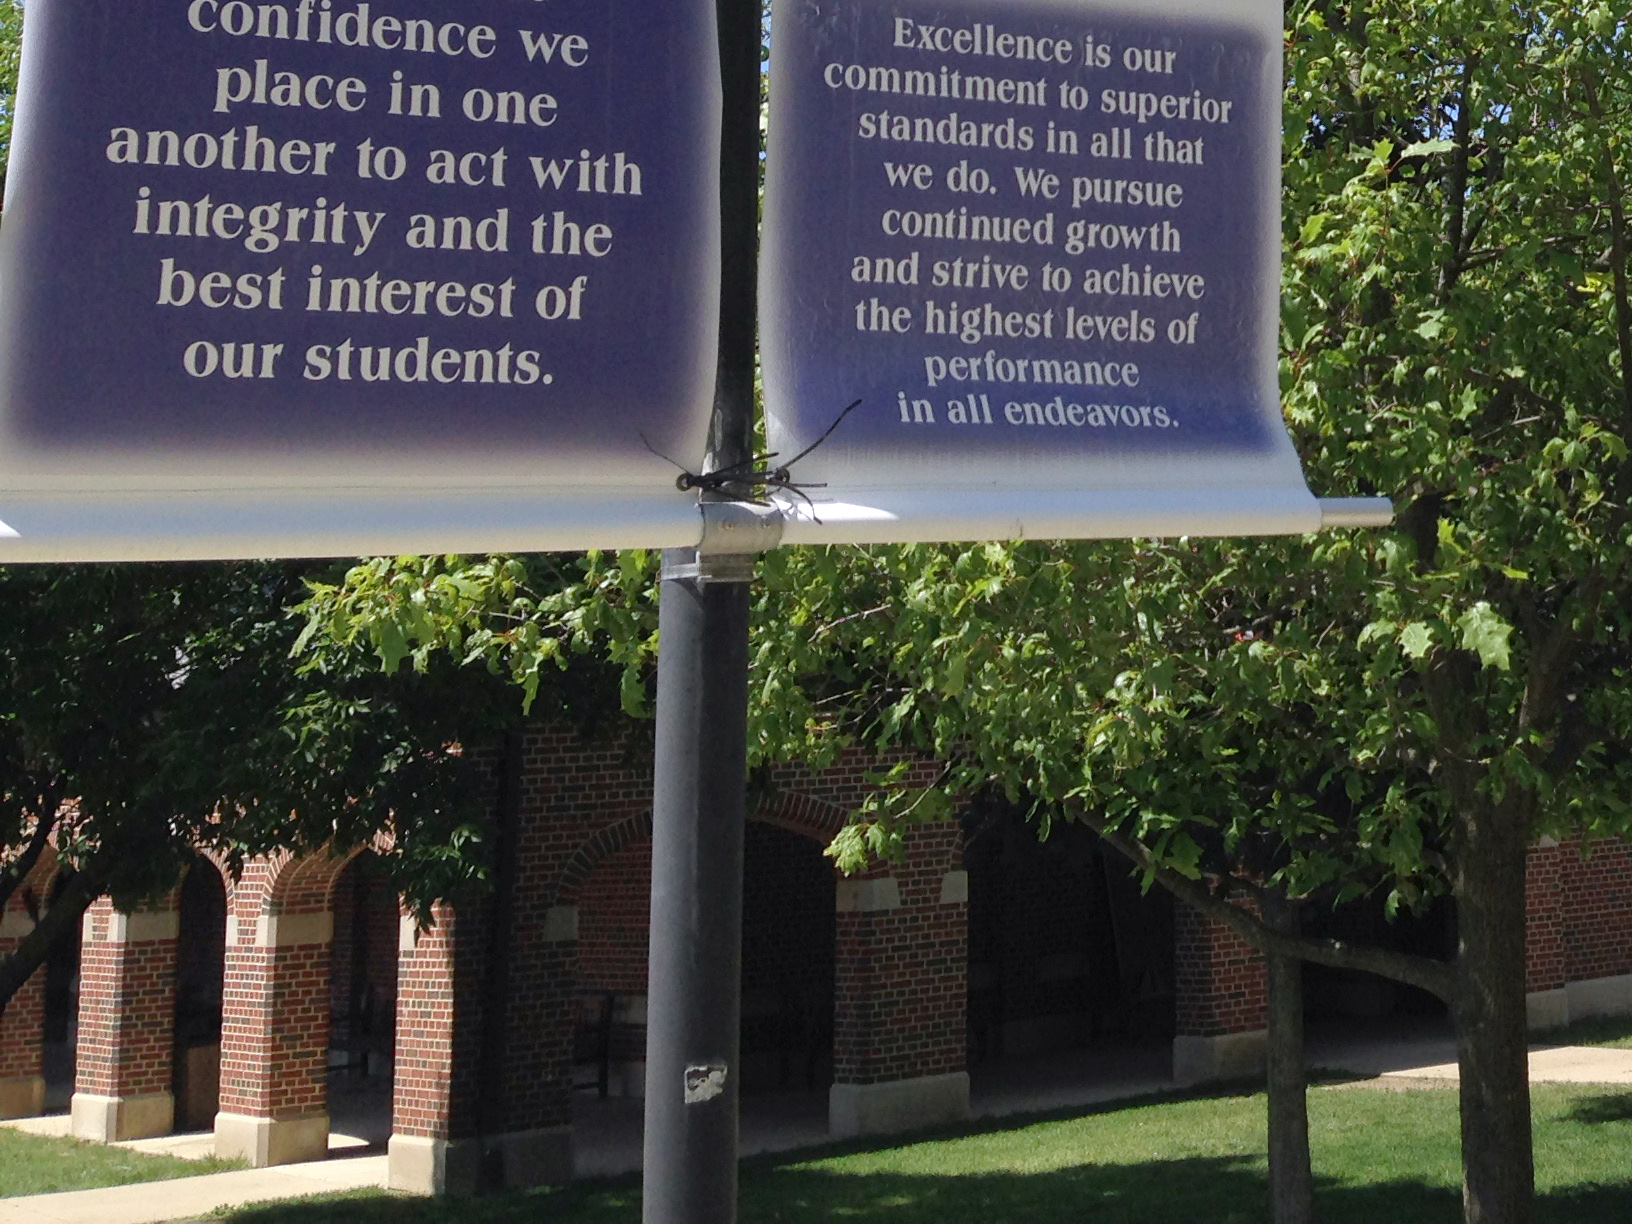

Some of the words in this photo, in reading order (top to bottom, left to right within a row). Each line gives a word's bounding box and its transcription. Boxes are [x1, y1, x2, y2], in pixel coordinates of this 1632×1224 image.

[518, 27, 589, 67] we
[893, 17, 1072, 64] Excellence
[1085, 35, 1110, 68] is
[1123, 46, 1176, 74] our
[212, 58, 366, 112] place
[387, 70, 441, 117] in
[462, 88, 558, 126] one
[824, 62, 1047, 106] commitment
[1059, 81, 1089, 111] to
[1100, 87, 1232, 124] superior
[106, 124, 336, 175] another
[357, 137, 406, 181] to
[426, 146, 507, 187] act
[529, 149, 643, 196] with
[859, 110, 1034, 151] standards
[1046, 121, 1078, 155] in
[1090, 126, 1131, 160] all
[1144, 132, 1203, 165] that
[884, 161, 932, 189] we
[947, 160, 996, 195] do.
[1014, 166, 1060, 199] We
[1072, 176, 1182, 208] pursue
[133, 186, 386, 256] integrity
[406, 208, 509, 252] and
[531, 211, 613, 257] the
[882, 207, 1053, 246] continued
[1065, 219, 1181, 255] growth
[156, 258, 287, 310] best
[305, 264, 516, 318] interest
[535, 276, 588, 320] of
[851, 251, 919, 285] and
[932, 255, 1028, 291] strive
[1042, 261, 1071, 293] to
[1083, 264, 1204, 299] achieve
[855, 298, 912, 333] the
[925, 300, 1053, 344] highest
[1066, 306, 1156, 343] levels
[1168, 311, 1200, 345] of
[183, 339, 284, 379] our
[303, 336, 554, 386] students.
[925, 349, 1139, 387] performance
[898, 392, 932, 423] in
[947, 394, 992, 424] all
[1004, 396, 1179, 428] endeavors.
